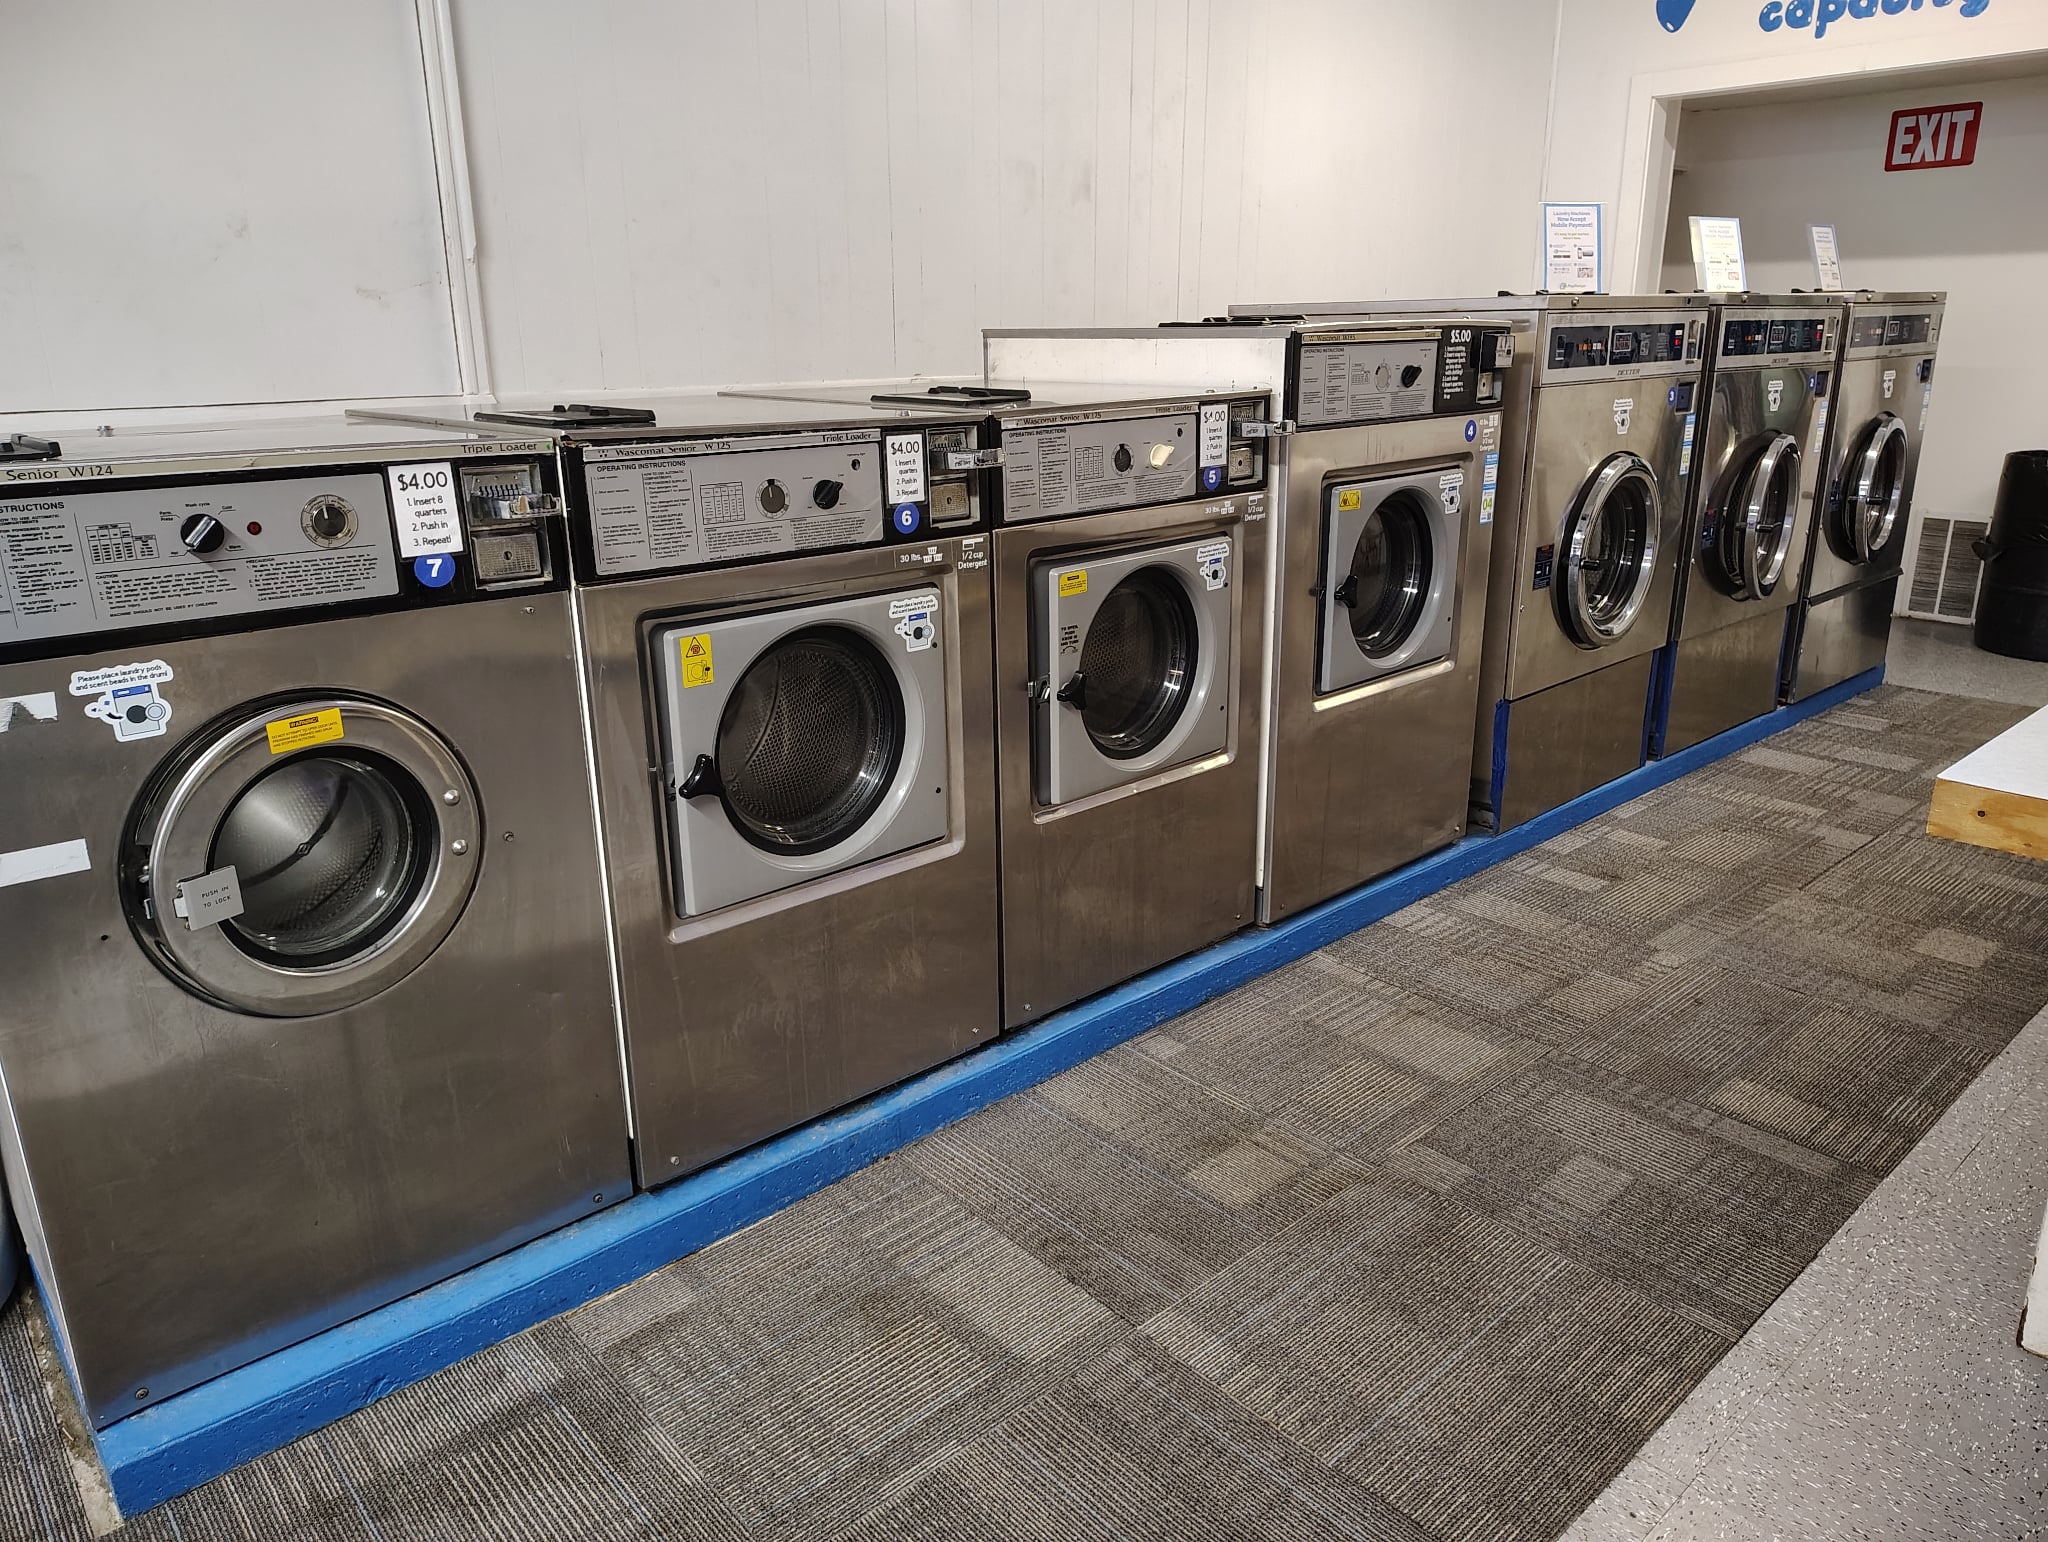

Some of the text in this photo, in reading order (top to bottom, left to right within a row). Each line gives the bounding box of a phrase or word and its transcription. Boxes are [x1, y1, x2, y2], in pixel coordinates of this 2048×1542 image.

[1758, 0, 1991, 39] capa
[1891, 109, 1974, 166] EXIT
[1451, 329, 1471, 343] $5.00
[1616, 368, 1640, 376] DEXTER
[1809, 378, 1814, 387] 2
[1669, 390, 1674, 401] 3
[1203, 410, 1226, 423] $4.00
[1467, 425, 1474, 437] 4
[822, 432, 872, 443] Triple Loader
[461, 442, 538, 454] Triple Loader
[615, 446, 664, 457] Wascomat
[668, 445, 697, 454] Senior
[890, 440, 920, 455] $4.00
[597, 460, 686, 472] OPERATING INSTRUCTIONS
[6, 469, 59, 480] Senior
[1208, 469, 1217, 483] 5
[397, 471, 448, 491] $4.00
[901, 477, 912, 485] Push
[413, 496, 436, 506] Insert
[437, 495, 444, 504] 8
[414, 507, 447, 519] quarters
[901, 510, 912, 526] 6
[412, 520, 448, 532] 2. Push in
[413, 538, 421, 547] 3.
[900, 554, 910, 563] 30
[961, 551, 984, 560] 1/2 cup
[426, 558, 443, 578] 7
[957, 559, 988, 570] Detergent
[77, 664, 162, 683] Please place laundry pods
[75, 683, 89, 691] and
[90, 680, 108, 690] scent
[109, 677, 129, 687] beads
[129, 675, 137, 683] in
[137, 673, 148, 682] the
[201, 884, 229, 898] PUSH IN
[203, 895, 231, 909] TO LOCK
